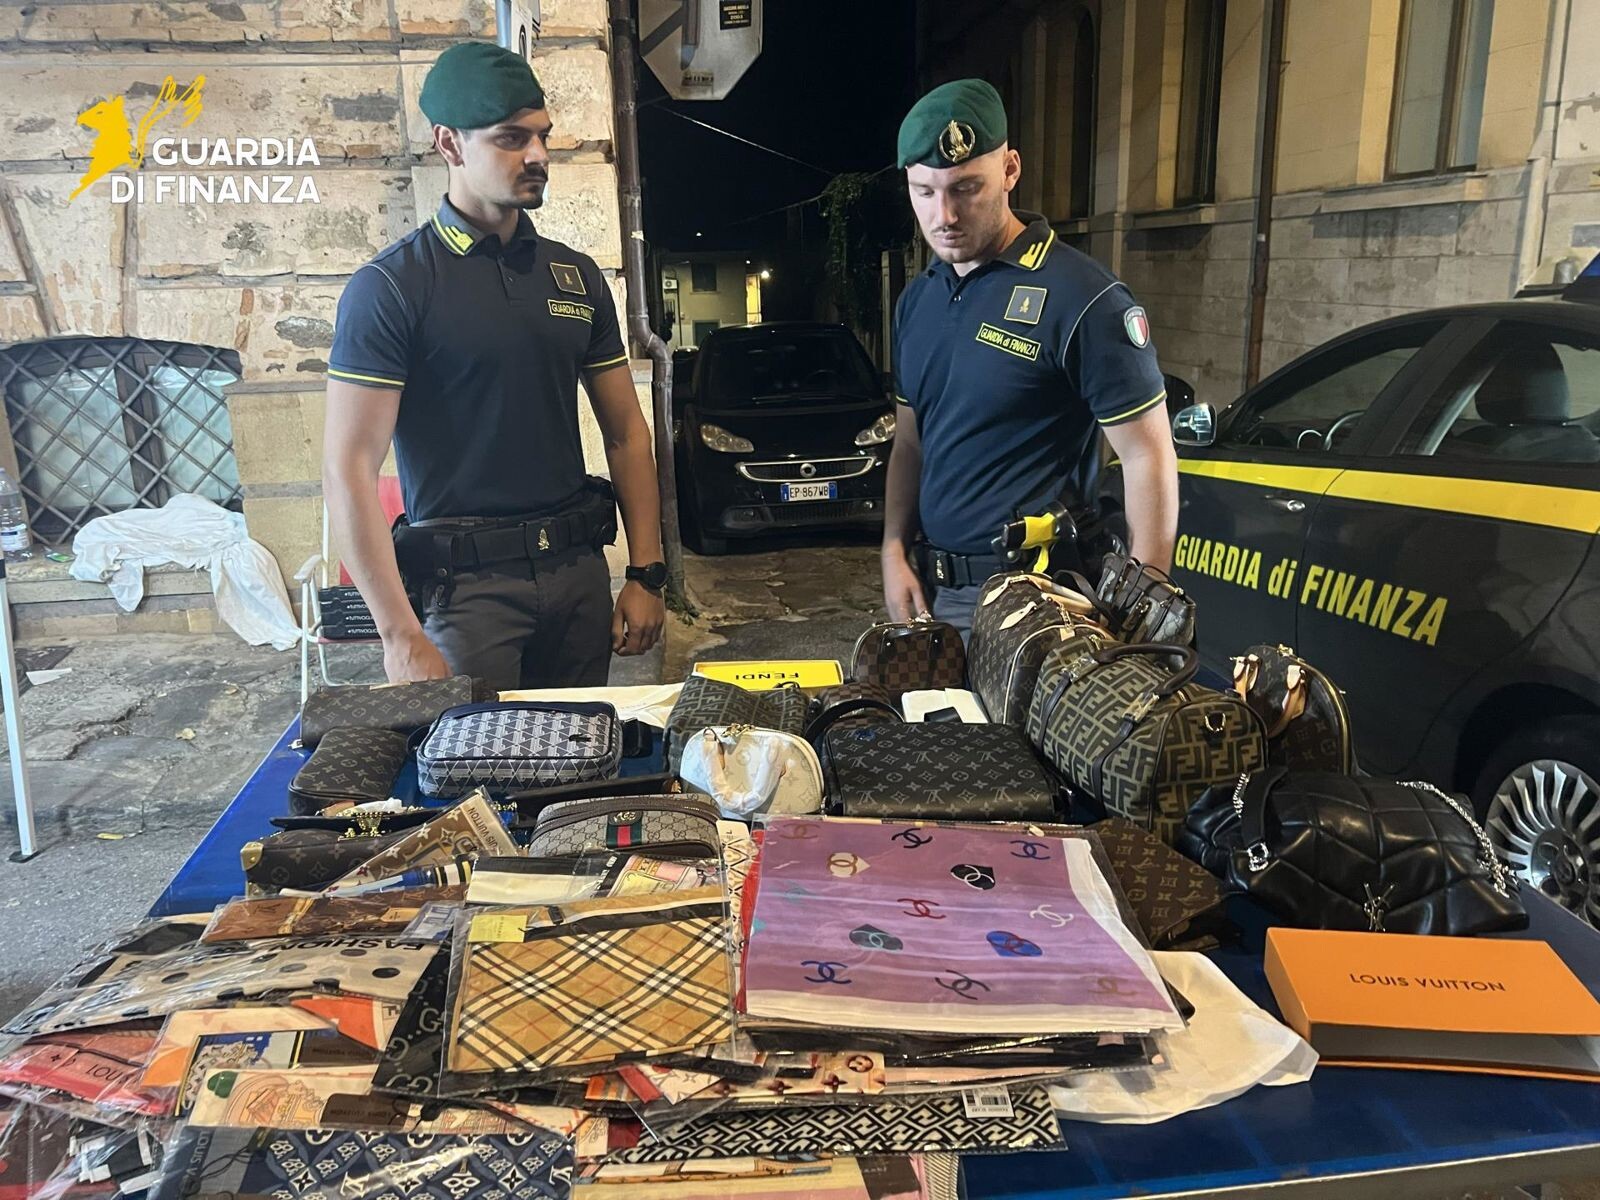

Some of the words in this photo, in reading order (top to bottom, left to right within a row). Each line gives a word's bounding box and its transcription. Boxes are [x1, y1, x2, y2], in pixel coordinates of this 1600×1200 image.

[551, 303, 576, 315] GUARDIA
[980, 328, 1004, 345] GUARDIA
[1002, 337, 1010, 347] di
[1009, 338, 1036, 357] FINANZA
[789, 487, 800, 498] EP
[1175, 534, 1262, 591] GUARDIA
[1267, 557, 1297, 599] di
[1300, 564, 1448, 647] FINANZA
[735, 672, 799, 680] FENDI
[467, 807, 489, 838] VUITTON
[269, 939, 426, 952] FASHION
[1349, 973, 1409, 987] LOUIS
[1414, 977, 1506, 992] VUITTON
